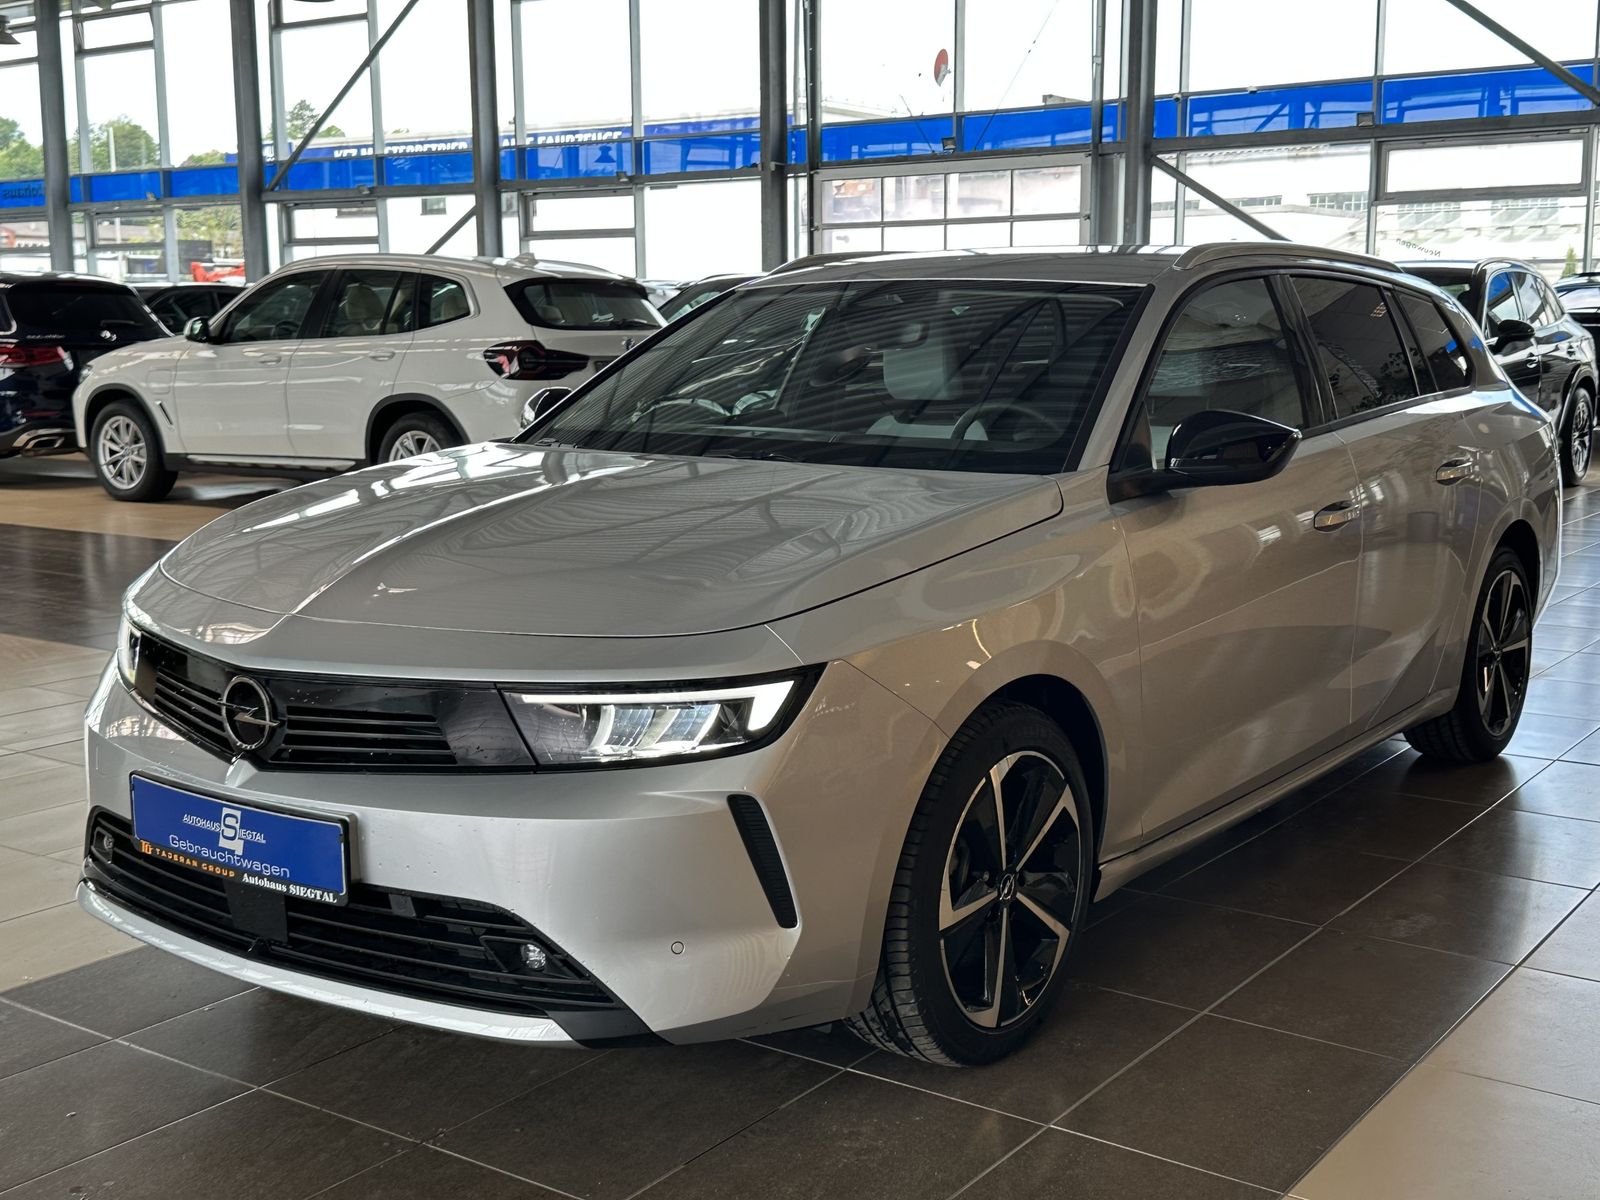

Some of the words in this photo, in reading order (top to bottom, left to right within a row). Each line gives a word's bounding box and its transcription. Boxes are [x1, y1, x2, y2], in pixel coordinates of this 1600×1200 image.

[182, 813, 221, 832] AUTOHAUS
[221, 813, 266, 843] SIEGTAL
[168, 834, 291, 878] Gebrauchtwagen
[201, 862, 235, 877] GROUP
[242, 872, 287, 893] Autohaus
[289, 883, 338, 904] SIEGTAL
